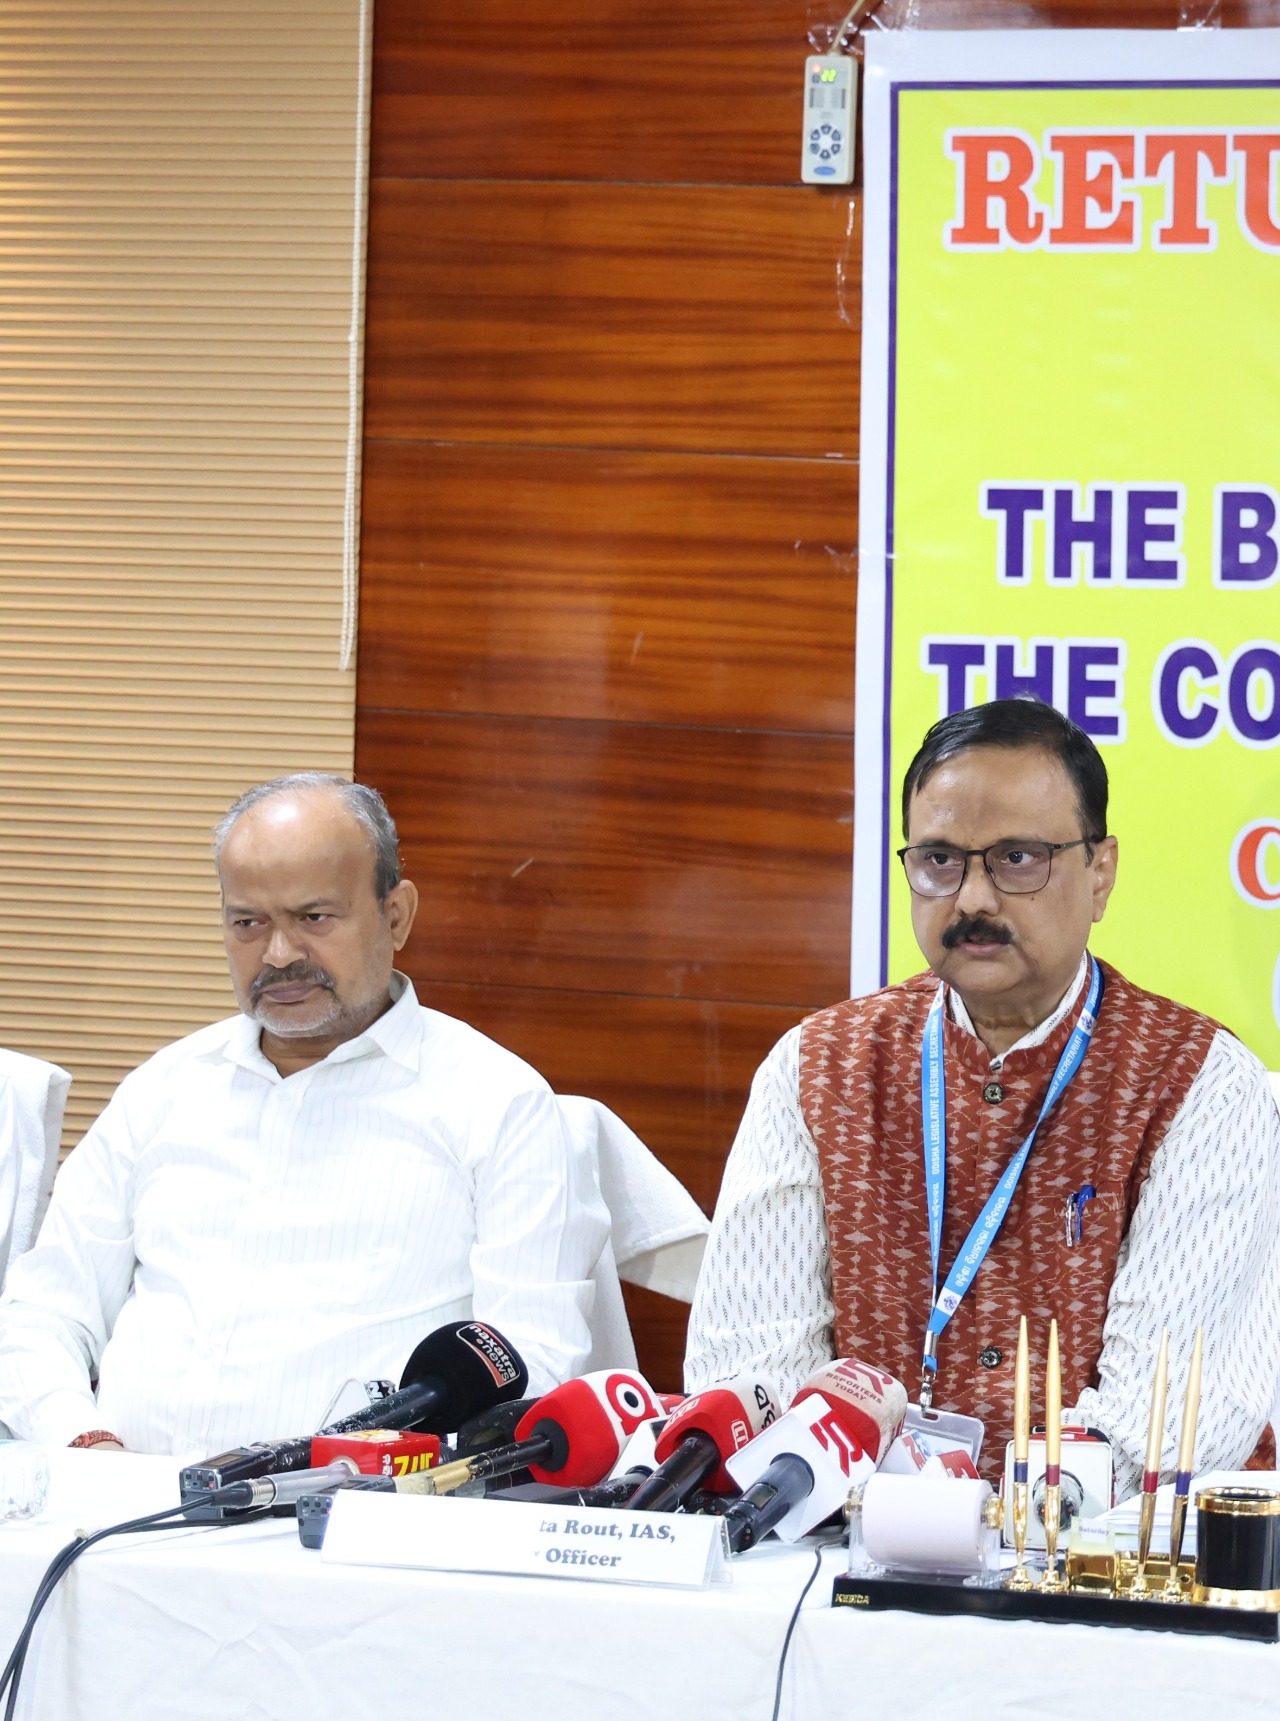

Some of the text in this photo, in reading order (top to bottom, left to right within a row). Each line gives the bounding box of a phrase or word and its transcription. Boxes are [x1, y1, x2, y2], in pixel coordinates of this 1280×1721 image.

[988, 489, 1177, 579] THE
[929, 644, 1118, 735] THE
[1057, 1035, 1082, 1081] SECRETARIAT
[930, 1015, 940, 1175] ODISHA LEGISLATIVE ASSEMBLY SECRETARIAT
[1004, 1162, 1021, 1189] ODISHA
[469, 1325, 516, 1378] naxatra
[482, 1344, 510, 1381] news
[826, 1372, 882, 1404] REPORTERS
[835, 1382, 867, 1401] TODAY
[564, 1519, 623, 1541] Rout,
[629, 1522, 676, 1544] IAS,
[545, 1548, 622, 1567] Officer
